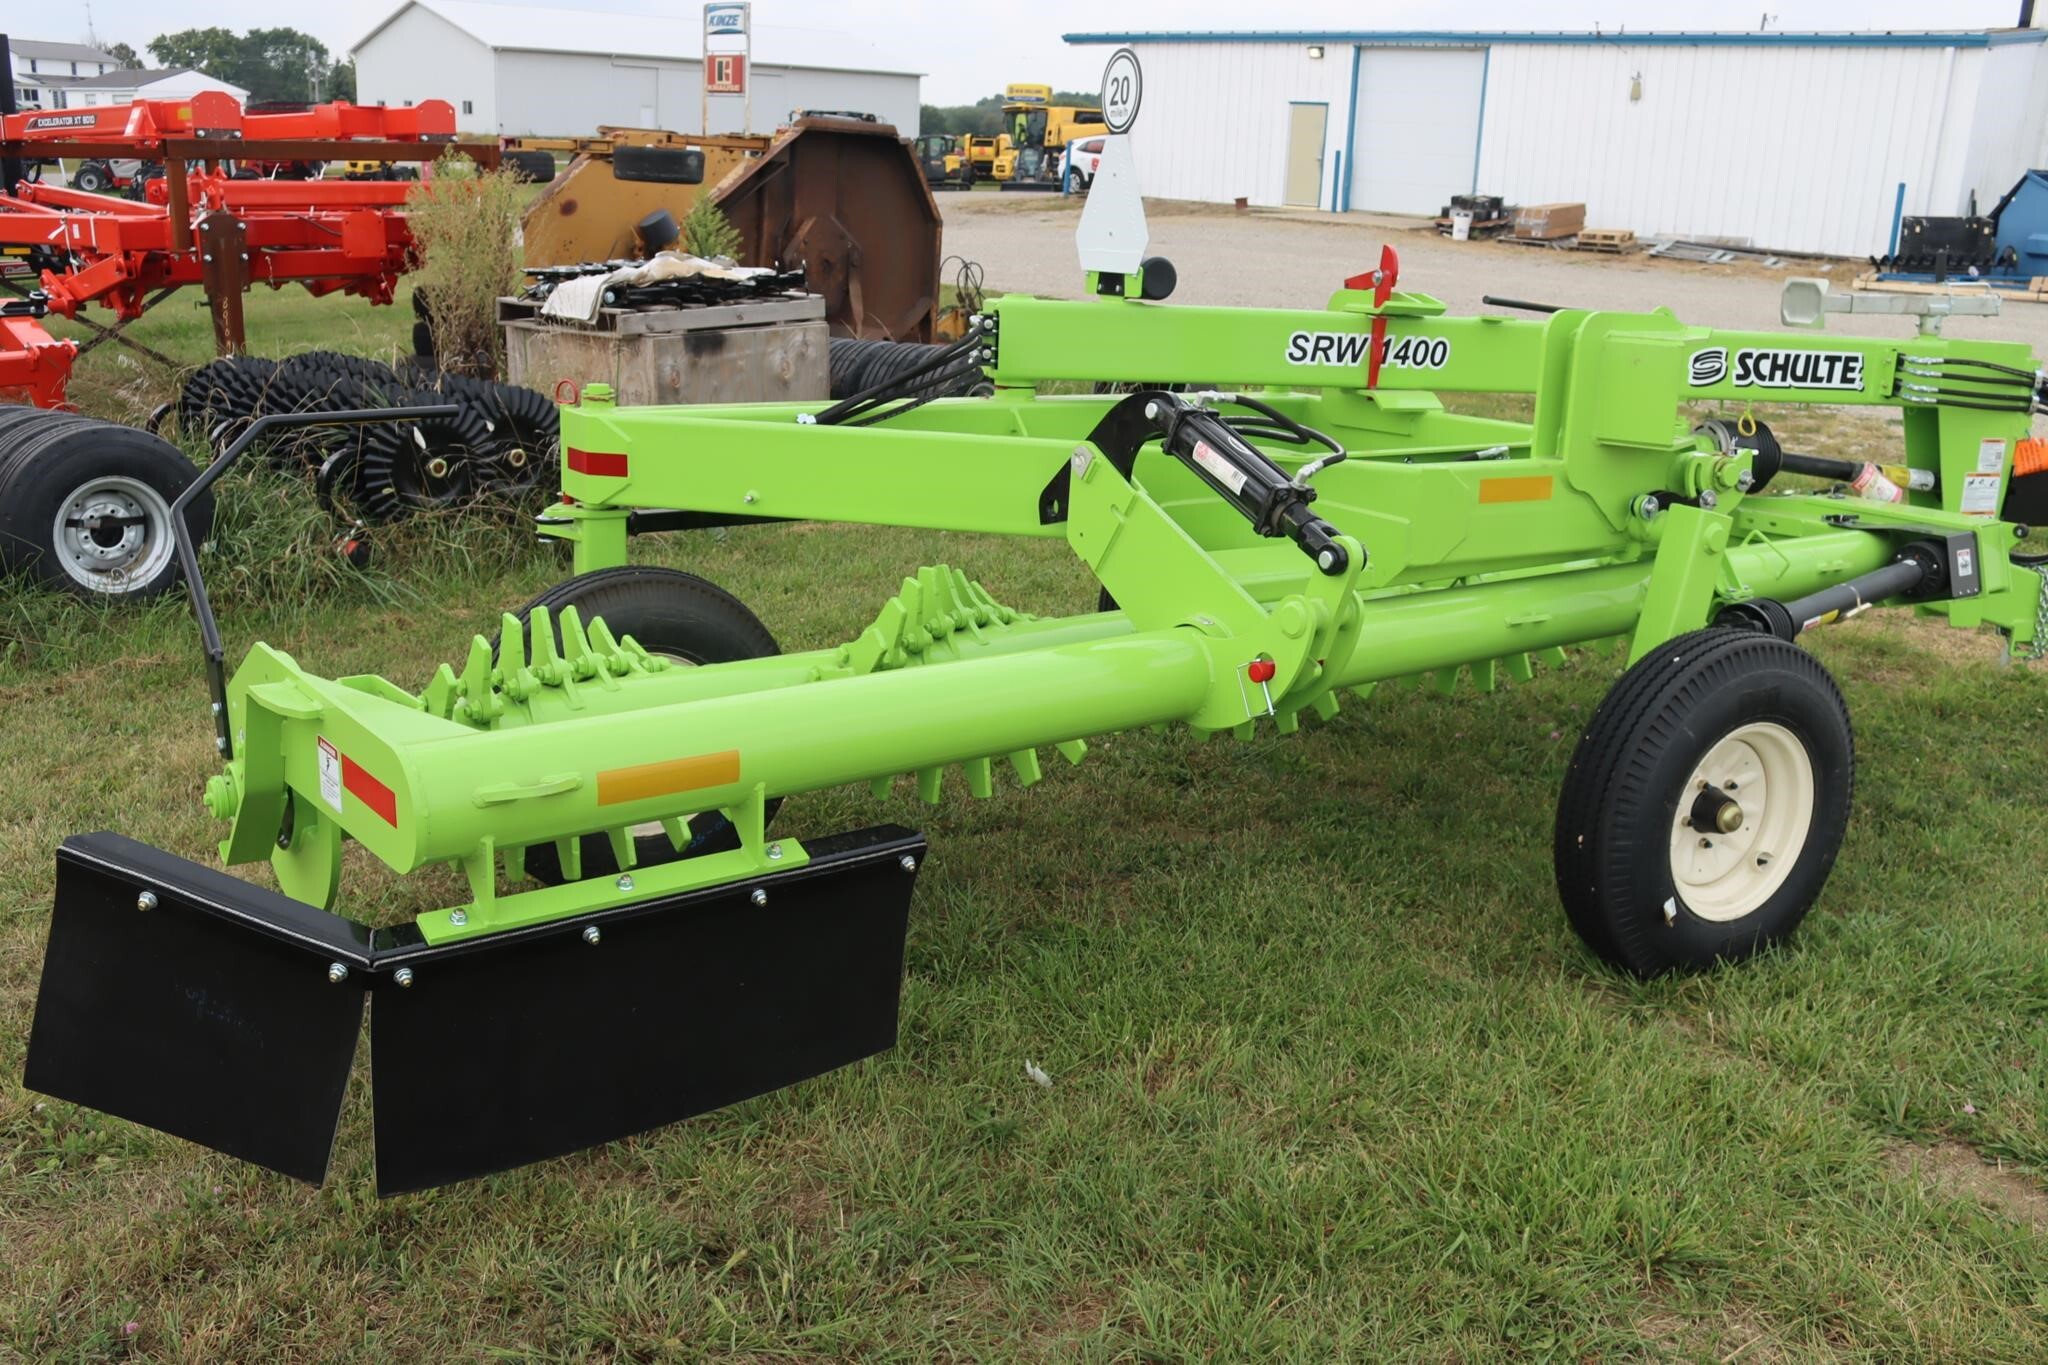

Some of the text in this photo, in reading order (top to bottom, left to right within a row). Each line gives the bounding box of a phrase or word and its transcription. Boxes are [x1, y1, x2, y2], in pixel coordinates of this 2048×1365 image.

[708, 14, 739, 26] KINZE
[1109, 76, 1130, 106] 20
[1288, 333, 1449, 367] SRW 1400
[1735, 351, 1861, 385] SCHULTE
